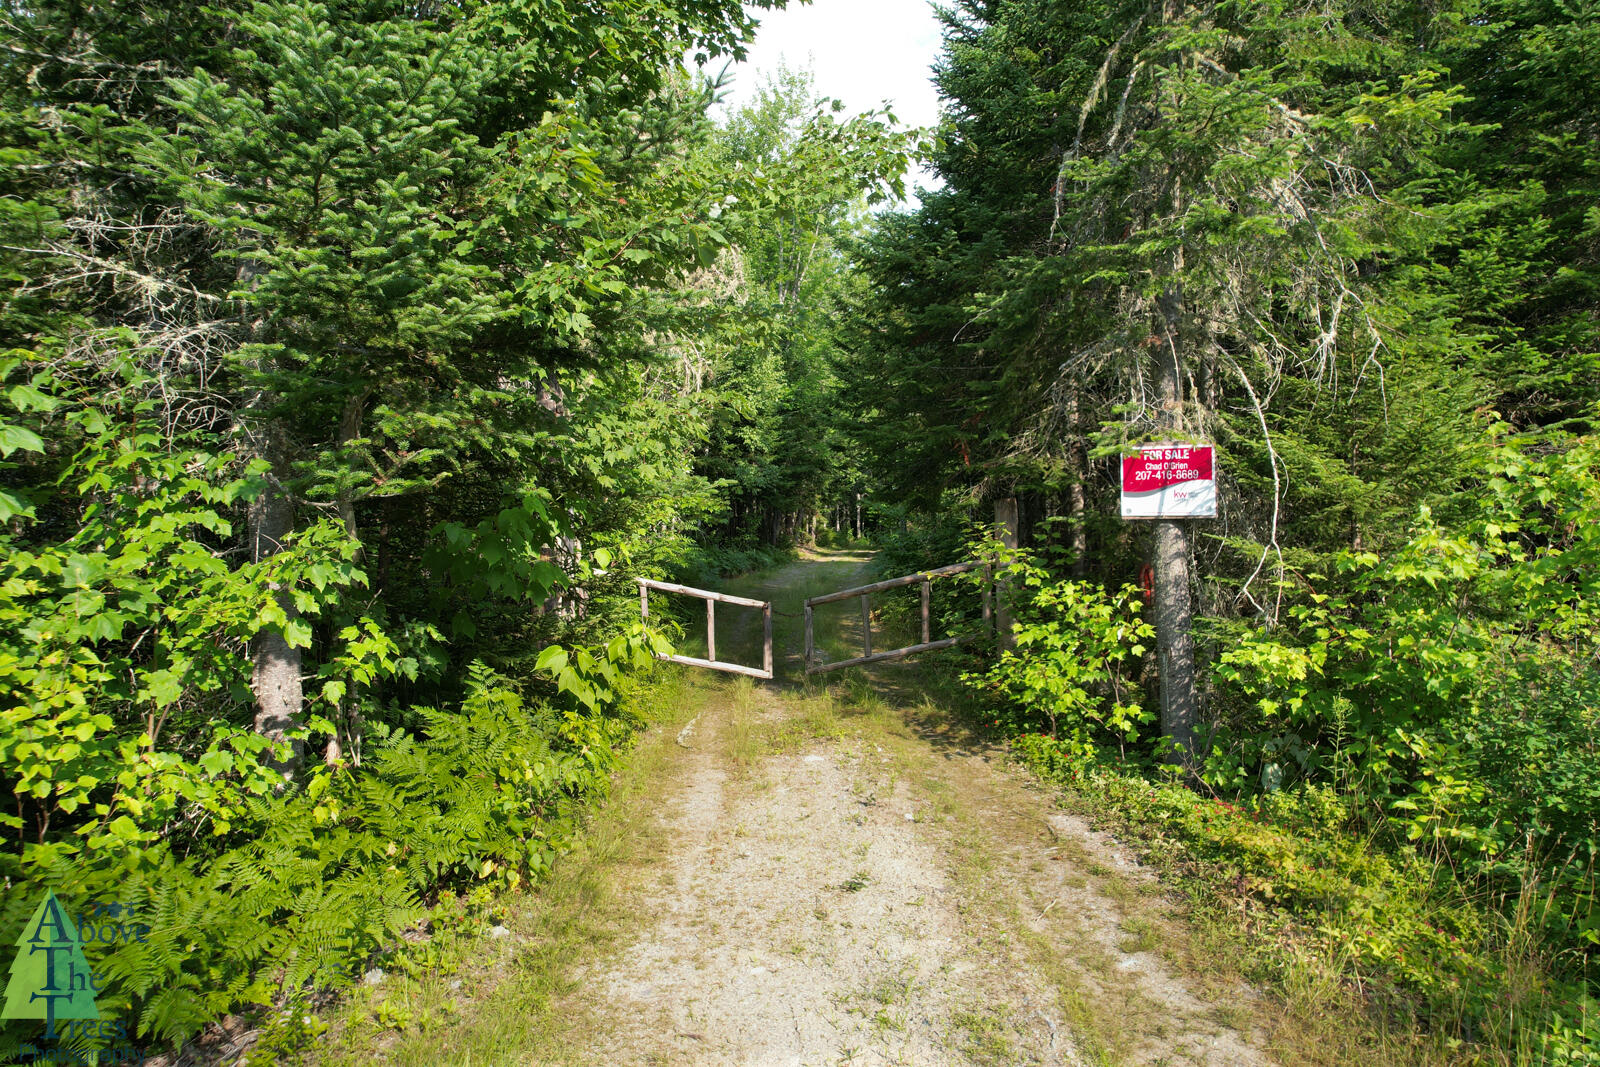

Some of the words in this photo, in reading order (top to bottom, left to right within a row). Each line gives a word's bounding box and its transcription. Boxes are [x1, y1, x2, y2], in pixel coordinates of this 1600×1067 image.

[1143, 450, 1163, 460] FOR
[1165, 449, 1190, 460] SALE
[1145, 462, 1162, 470] Chad
[1173, 489, 1188, 498] kw
